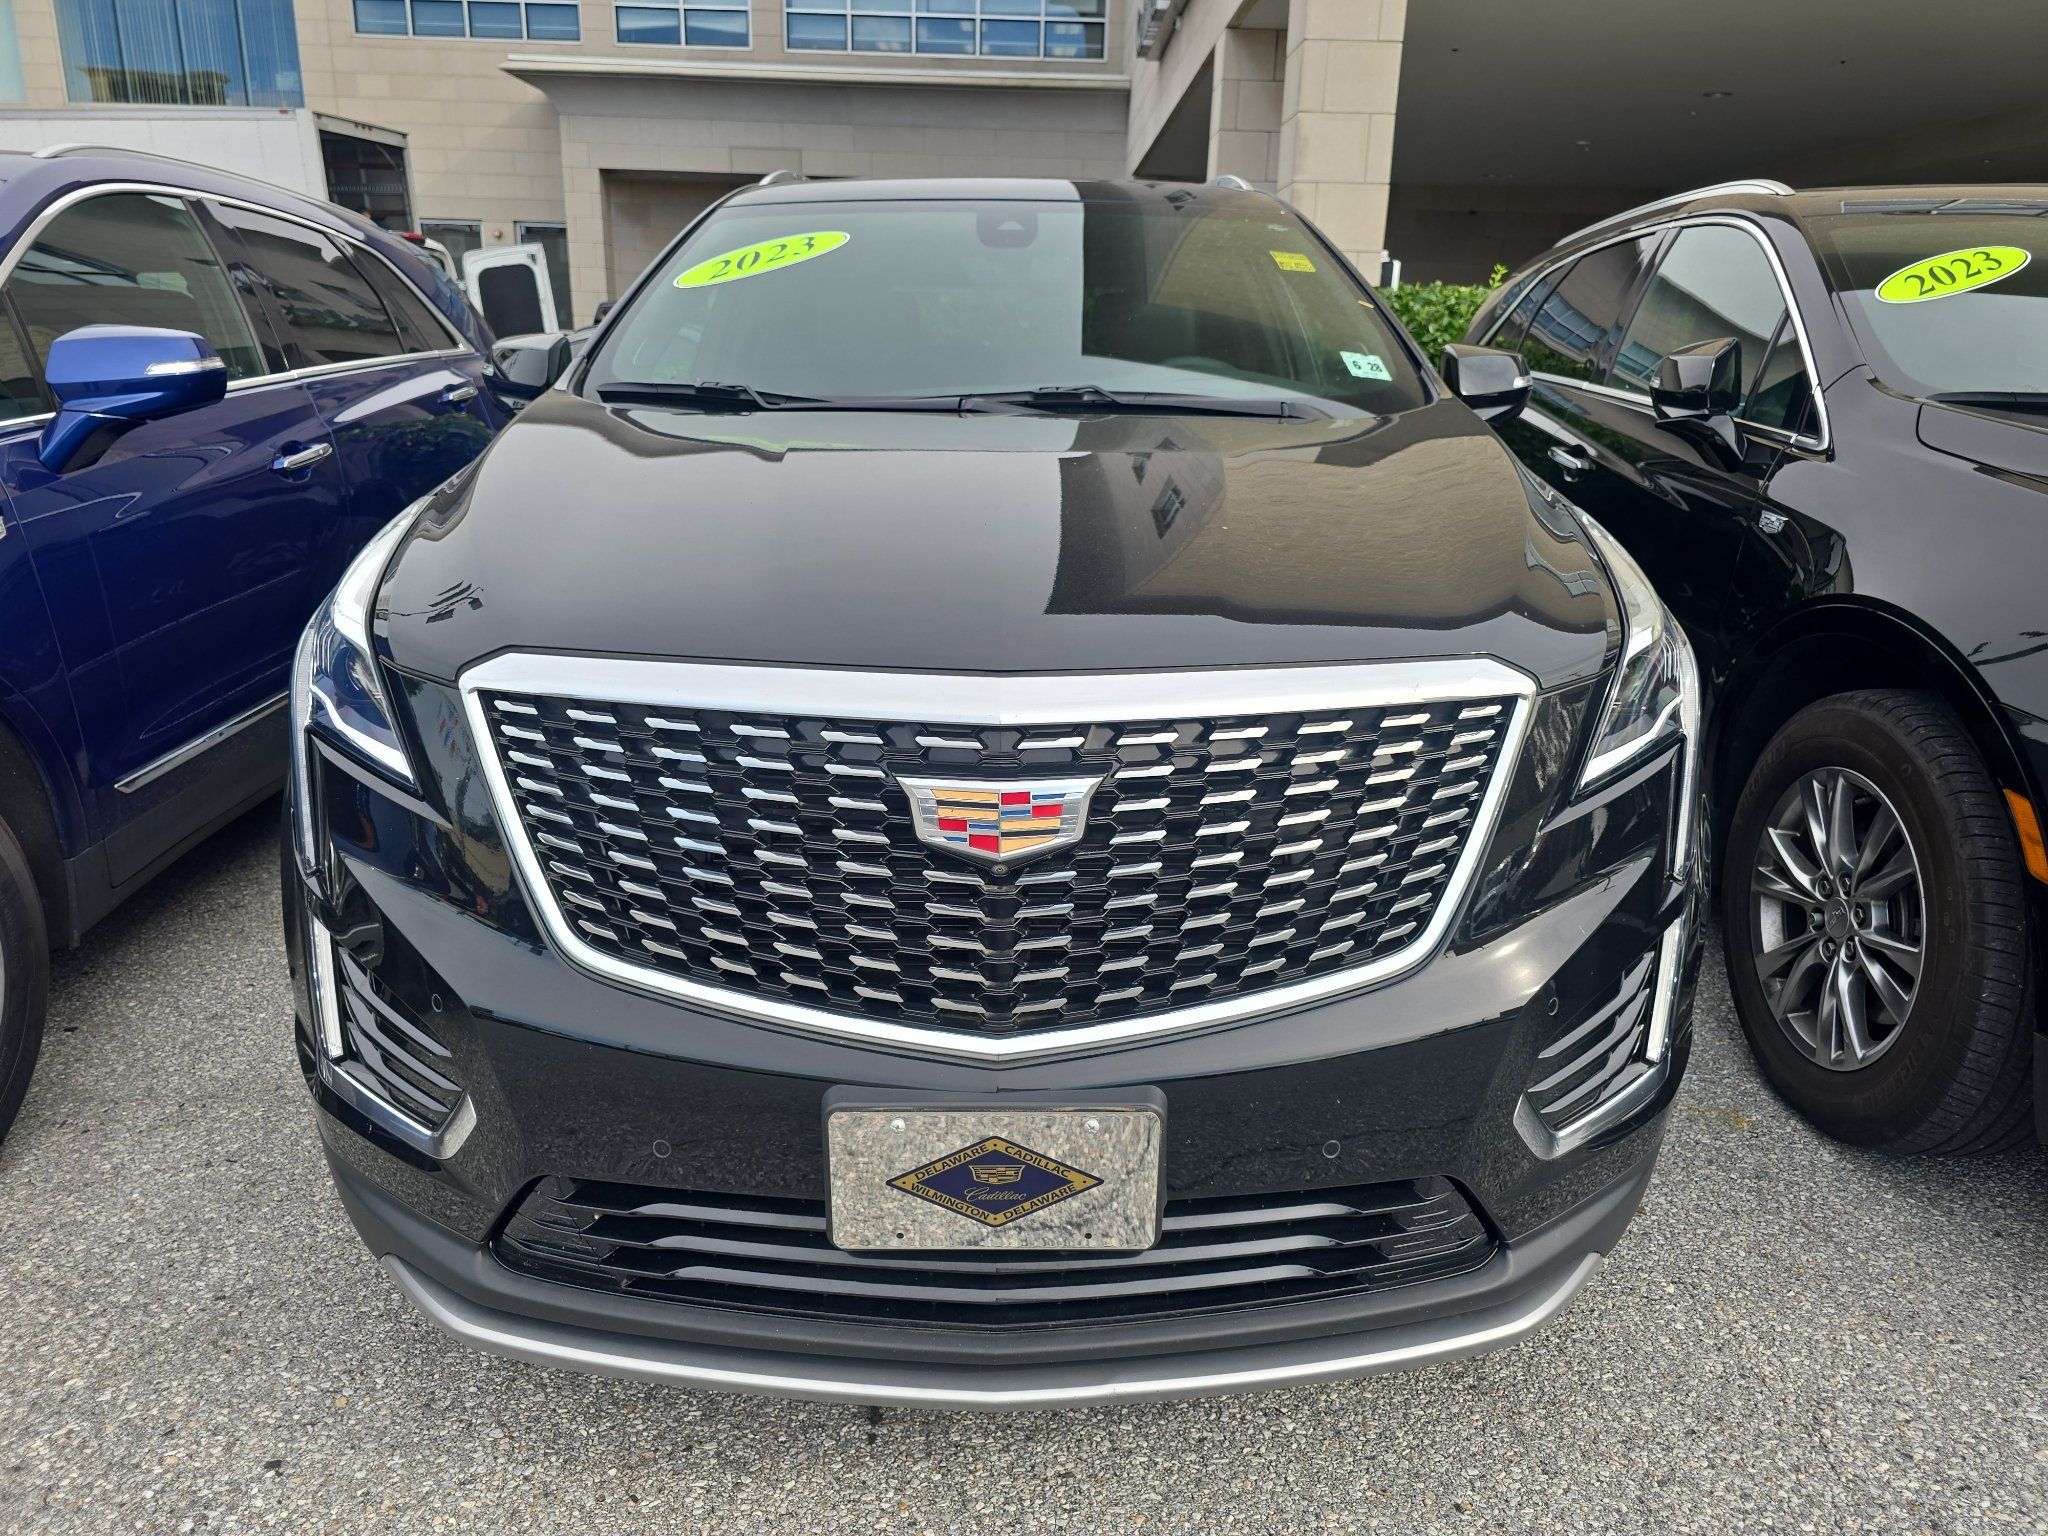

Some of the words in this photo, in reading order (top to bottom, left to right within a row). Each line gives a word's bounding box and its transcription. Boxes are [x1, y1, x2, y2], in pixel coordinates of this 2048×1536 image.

[709, 236, 815, 281] 2023
[1904, 251, 2002, 296] 2023
[914, 1144, 989, 1181] DELAWARE
[1004, 1145, 1072, 1178] CADILLAC
[911, 1182, 991, 1221] WILMINGTON
[1002, 1184, 1078, 1220] DELAWARE
[964, 1187, 1028, 1202] Cadillac
